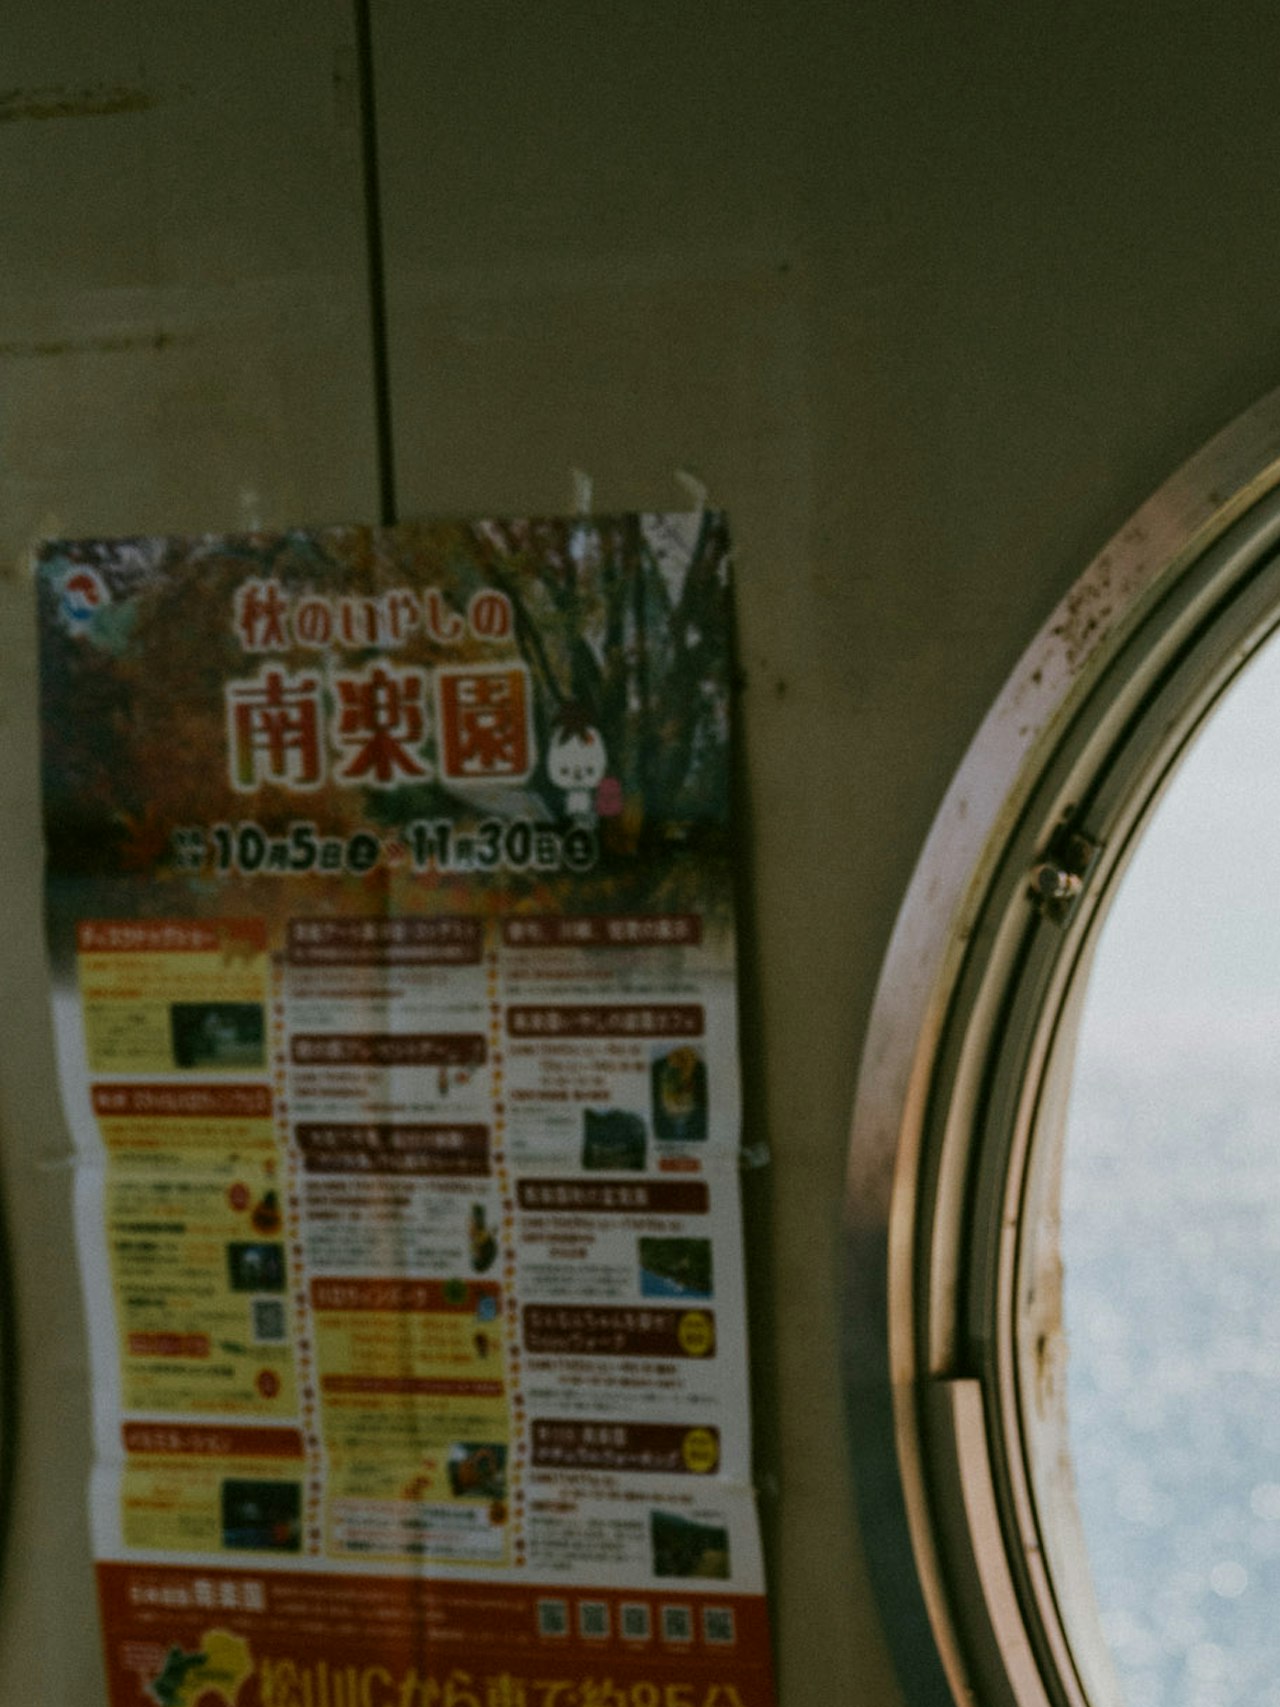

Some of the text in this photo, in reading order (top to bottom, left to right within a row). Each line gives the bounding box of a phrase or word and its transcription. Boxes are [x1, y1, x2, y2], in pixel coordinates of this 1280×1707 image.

[236, 581, 513, 651] 秋のいやしの
[228, 665, 535, 790] 南楽園
